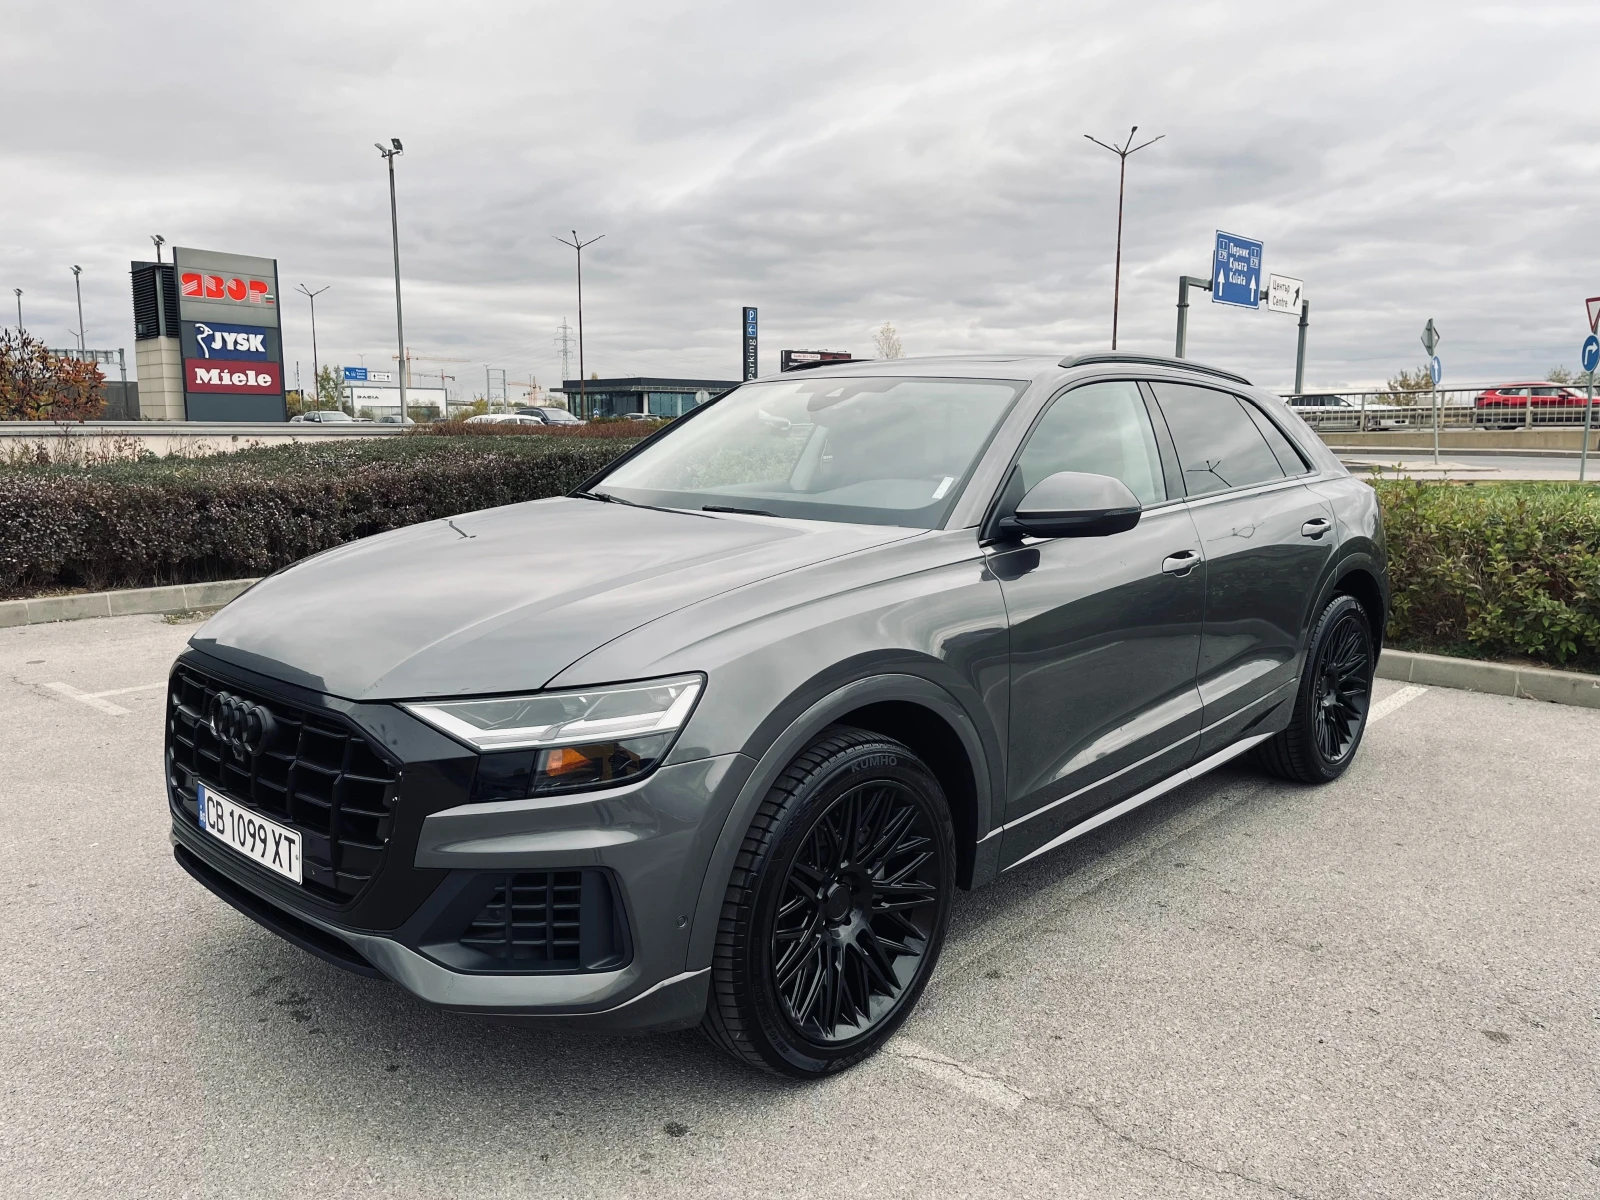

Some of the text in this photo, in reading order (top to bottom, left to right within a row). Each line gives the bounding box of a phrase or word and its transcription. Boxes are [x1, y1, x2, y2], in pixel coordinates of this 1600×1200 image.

[1229, 243, 1249, 258] Перник
[1229, 257, 1248, 272] Кулата
[1229, 271, 1246, 285] Kulata
[181, 273, 269, 304] ЯВОР
[1272, 280, 1291, 295] Център
[1272, 295, 1288, 308] Centre
[749, 311, 754, 321] P
[211, 331, 266, 352] JYSK
[747, 338, 757, 380] Parking
[194, 367, 272, 387] Miele
[851, 755, 898, 773] KUMHO
[207, 796, 296, 872] CB 1099 XT
